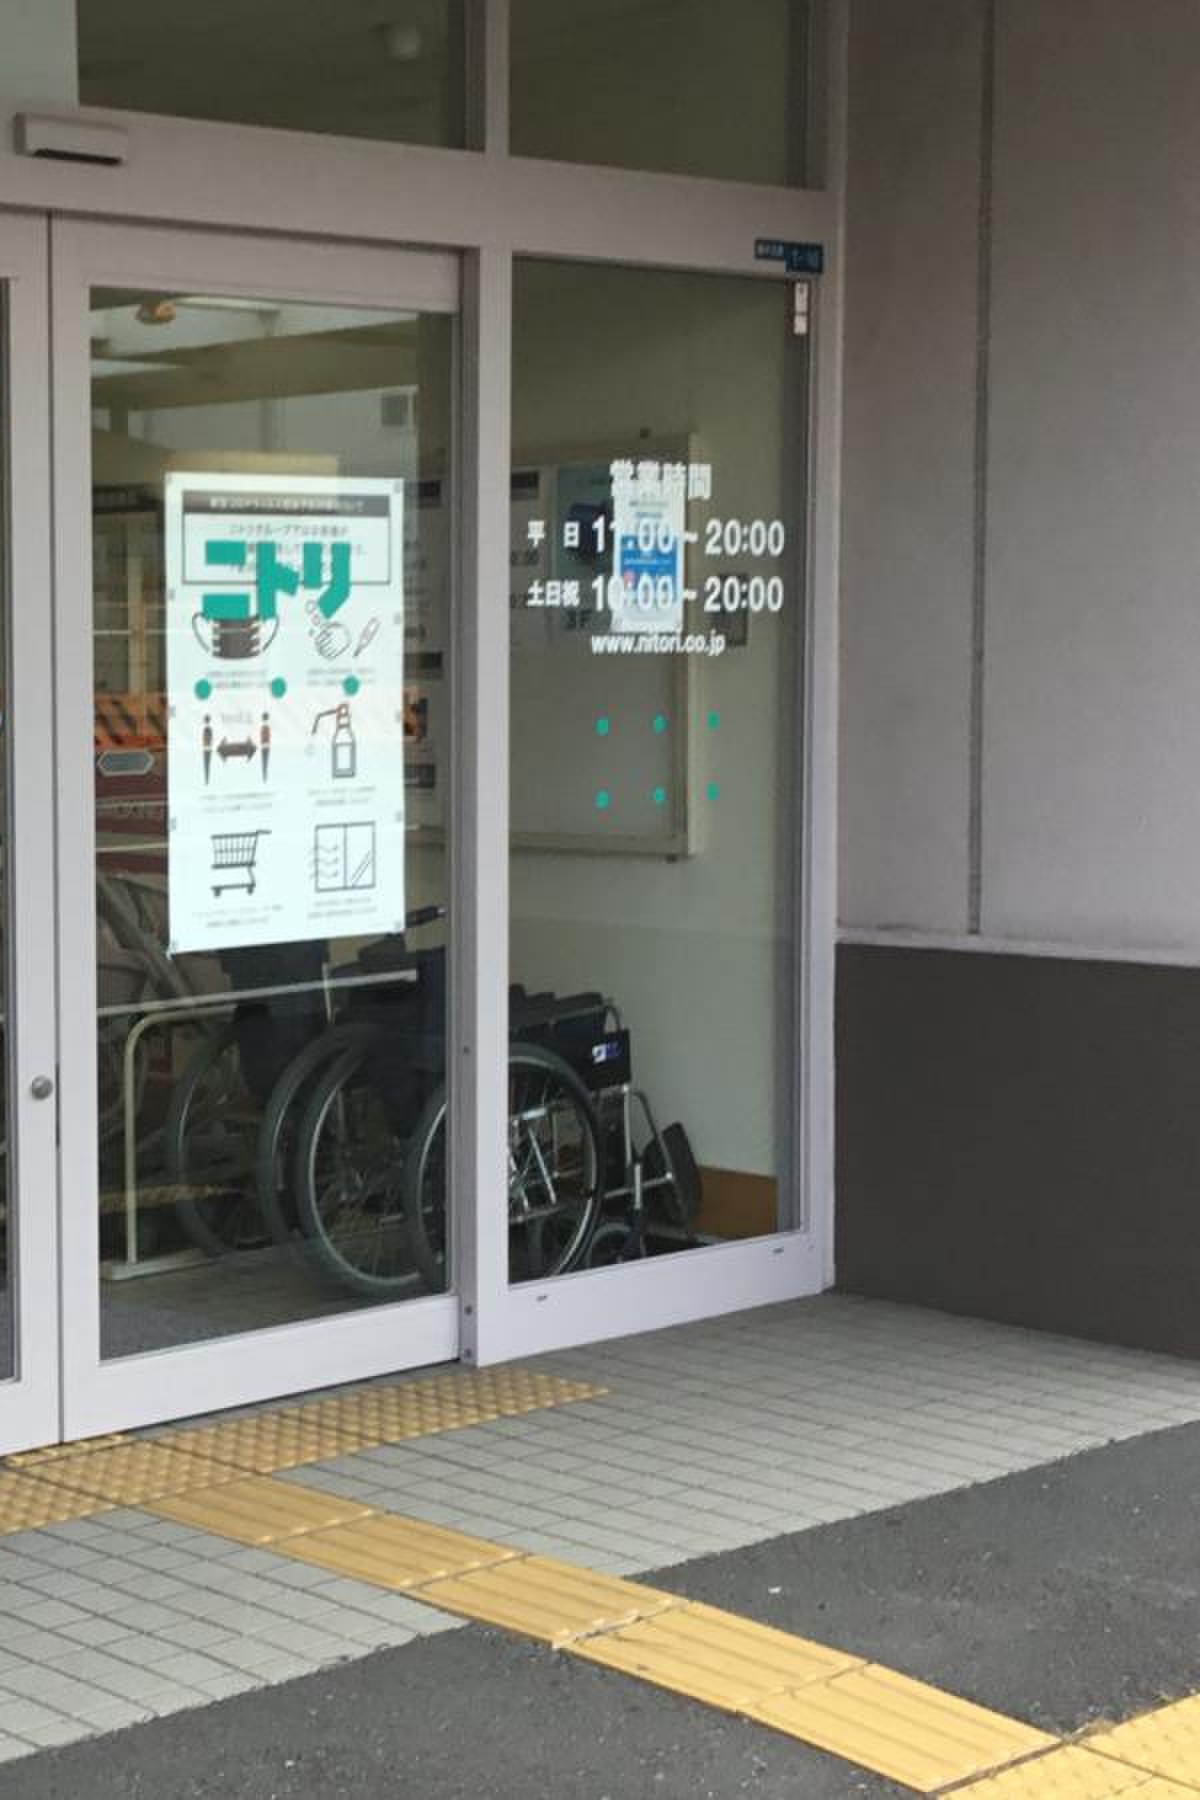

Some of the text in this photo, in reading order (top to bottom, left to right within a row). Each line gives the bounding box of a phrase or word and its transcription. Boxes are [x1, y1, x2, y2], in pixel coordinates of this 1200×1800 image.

[202, 540, 351, 620] ニトリ
[591, 628, 726, 657] www.nitori.co.jp
